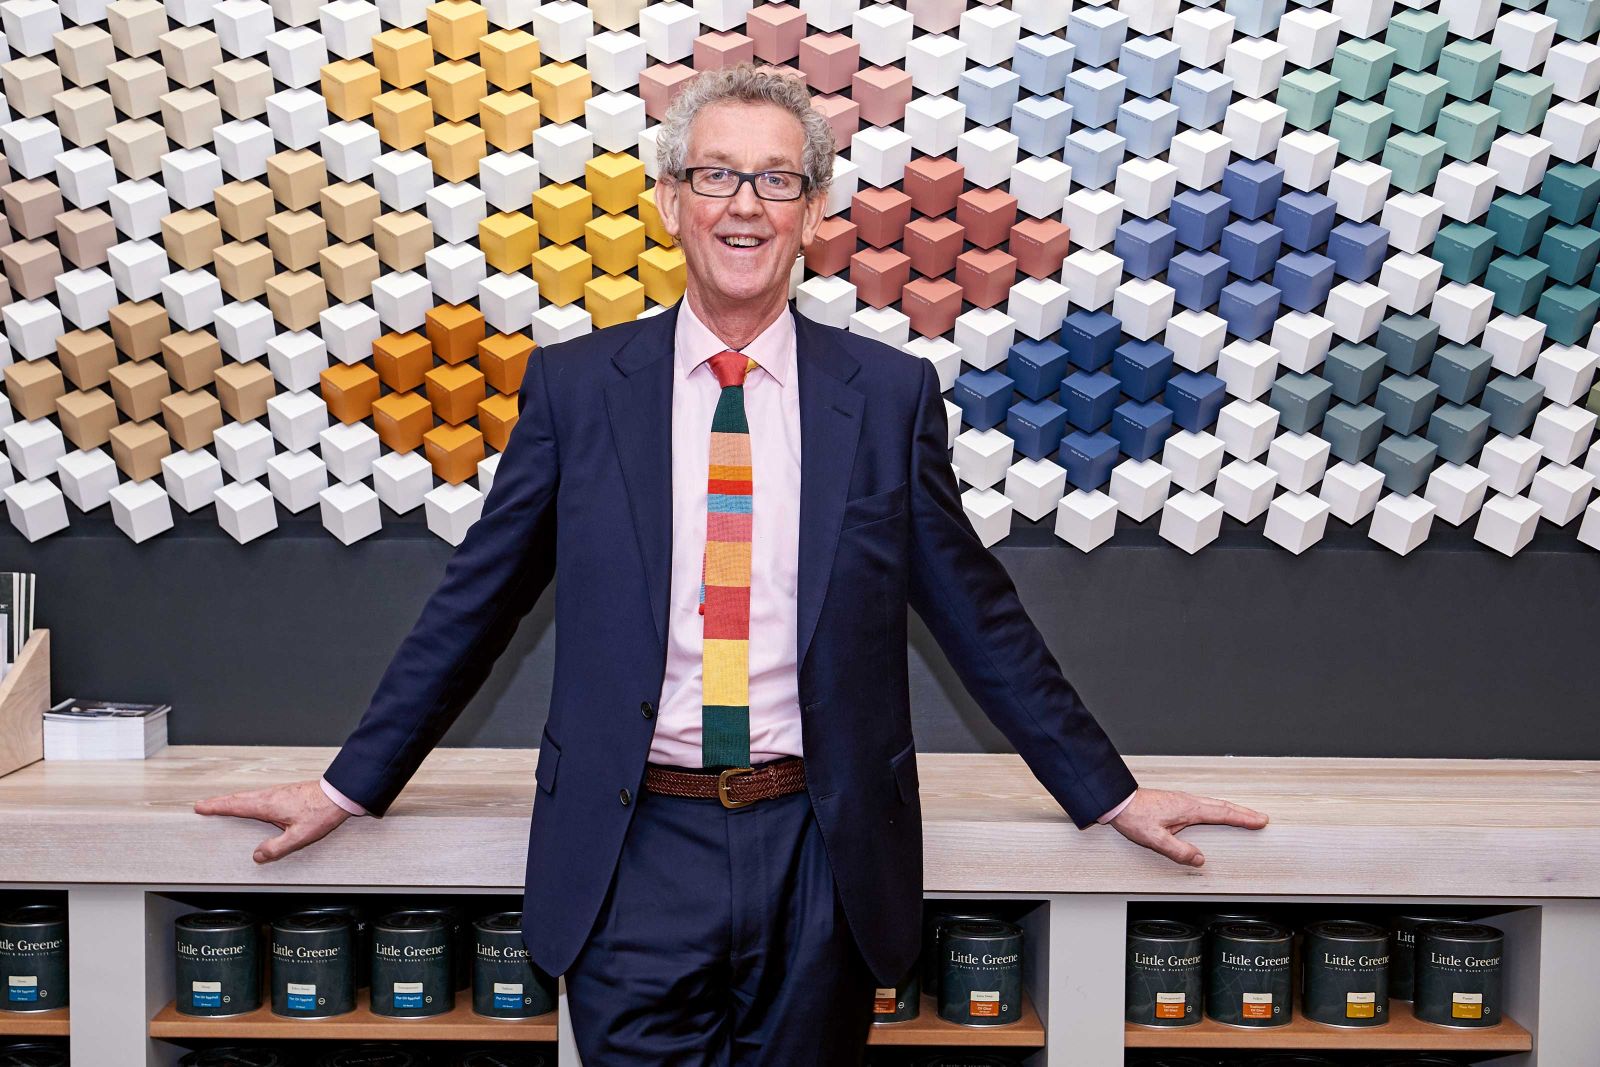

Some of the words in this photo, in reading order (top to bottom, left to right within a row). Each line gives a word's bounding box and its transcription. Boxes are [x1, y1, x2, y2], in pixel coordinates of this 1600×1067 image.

[1397, 930, 1415, 943] Litt
[17, 940, 60, 951] Greene
[177, 941, 198, 956] Little
[201, 945, 243, 956] Greene
[273, 942, 293, 957] Little
[296, 947, 338, 958] Greene
[376, 943, 401, 957] Little
[404, 946, 443, 957] Greene
[477, 943, 500, 957] Little
[951, 951, 979, 965] Little
[982, 954, 1018, 965] Greene
[1135, 952, 1164, 966] Little
[1222, 952, 1251, 966] Little
[1255, 956, 1290, 967] Greene
[1325, 952, 1355, 966] Little
[1431, 952, 1461, 966] Little
